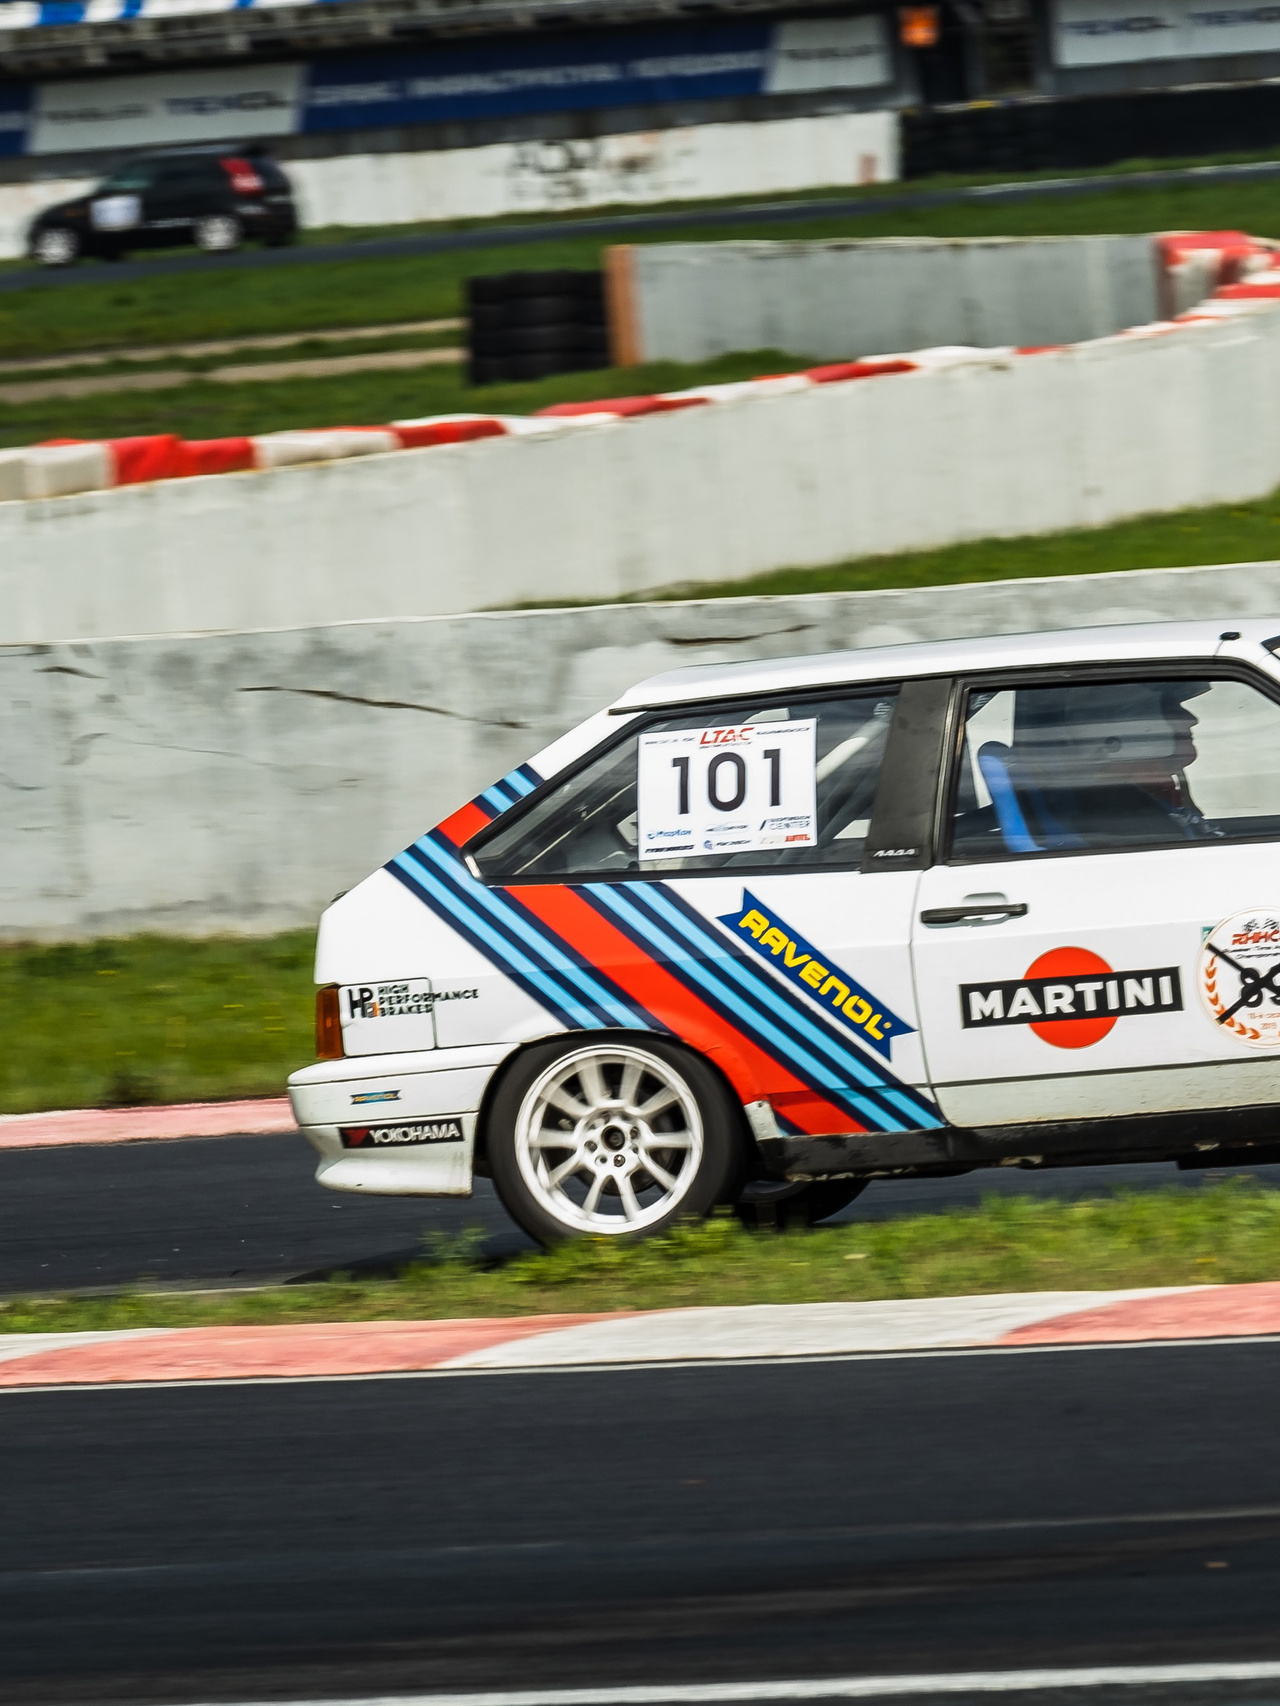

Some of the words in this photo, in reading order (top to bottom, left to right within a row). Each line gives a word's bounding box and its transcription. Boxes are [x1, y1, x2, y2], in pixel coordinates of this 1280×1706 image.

[672, 748, 782, 815] 101
[738, 909, 886, 1041] RAVENOL
[379, 988, 479, 1005] PERFORMANCE
[379, 1003, 433, 1017] BRAKES
[968, 974, 1174, 1022] MARTINI
[369, 1122, 461, 1144] YOKOHAMA
